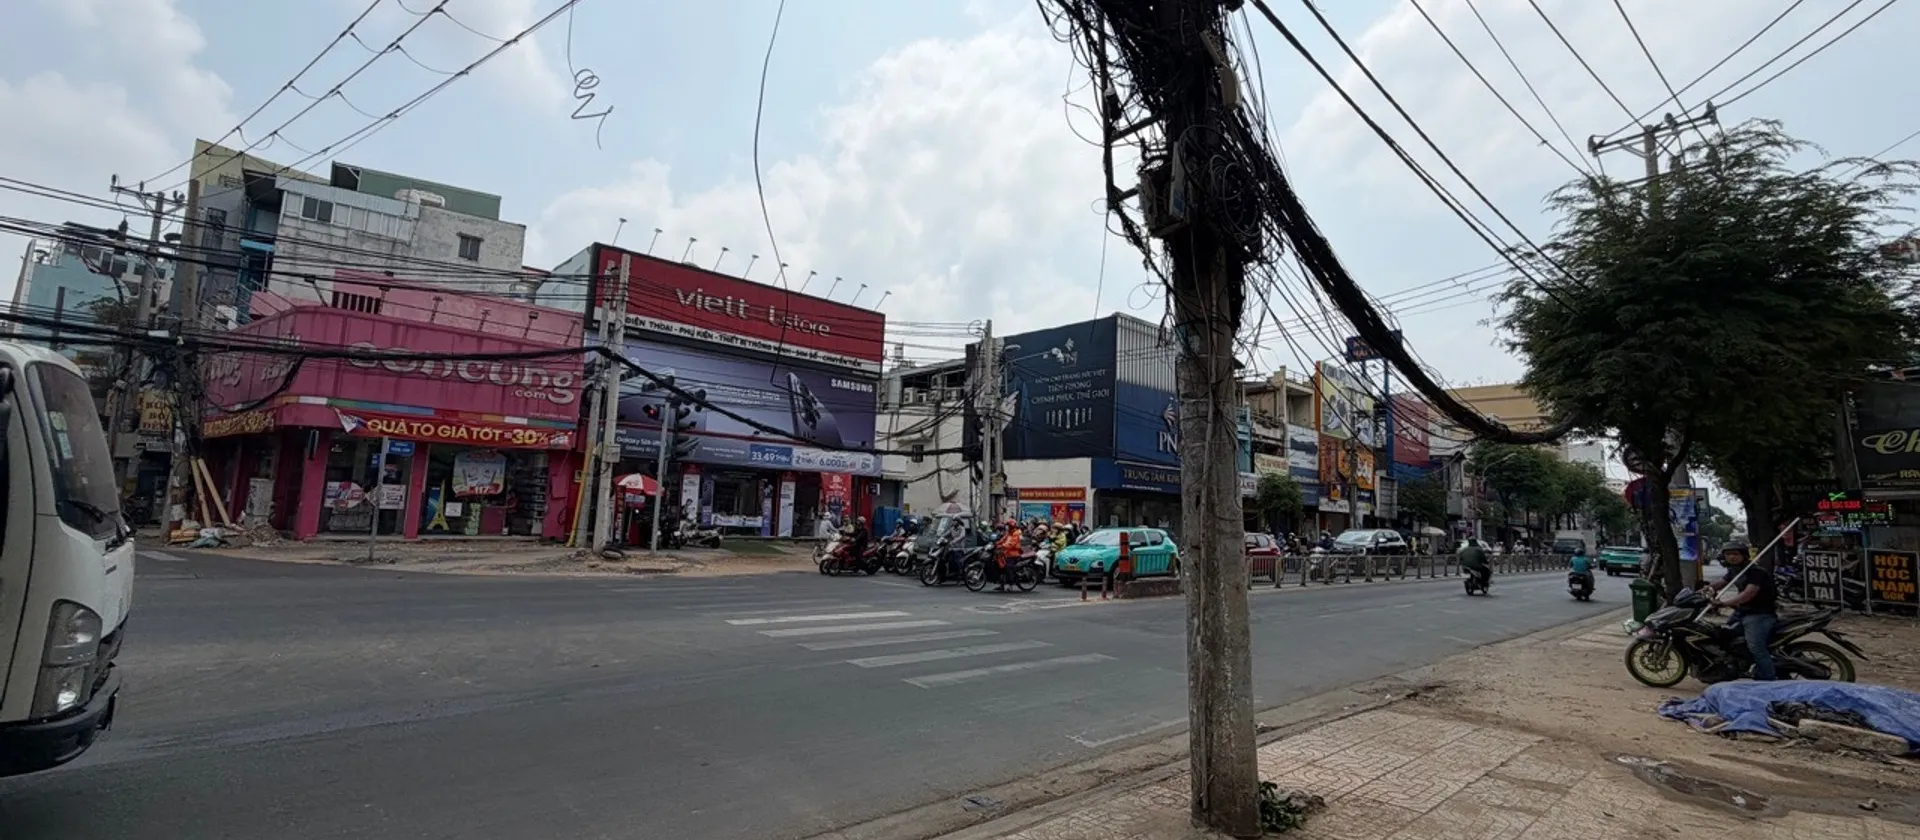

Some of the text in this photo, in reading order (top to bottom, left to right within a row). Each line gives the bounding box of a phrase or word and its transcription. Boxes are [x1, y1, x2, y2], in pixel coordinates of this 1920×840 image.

[830, 378, 873, 393] SAMSUNG
[410, 422, 435, 437] TO
[1812, 586, 1835, 600] TAI
[1872, 580, 1916, 593] NAM
